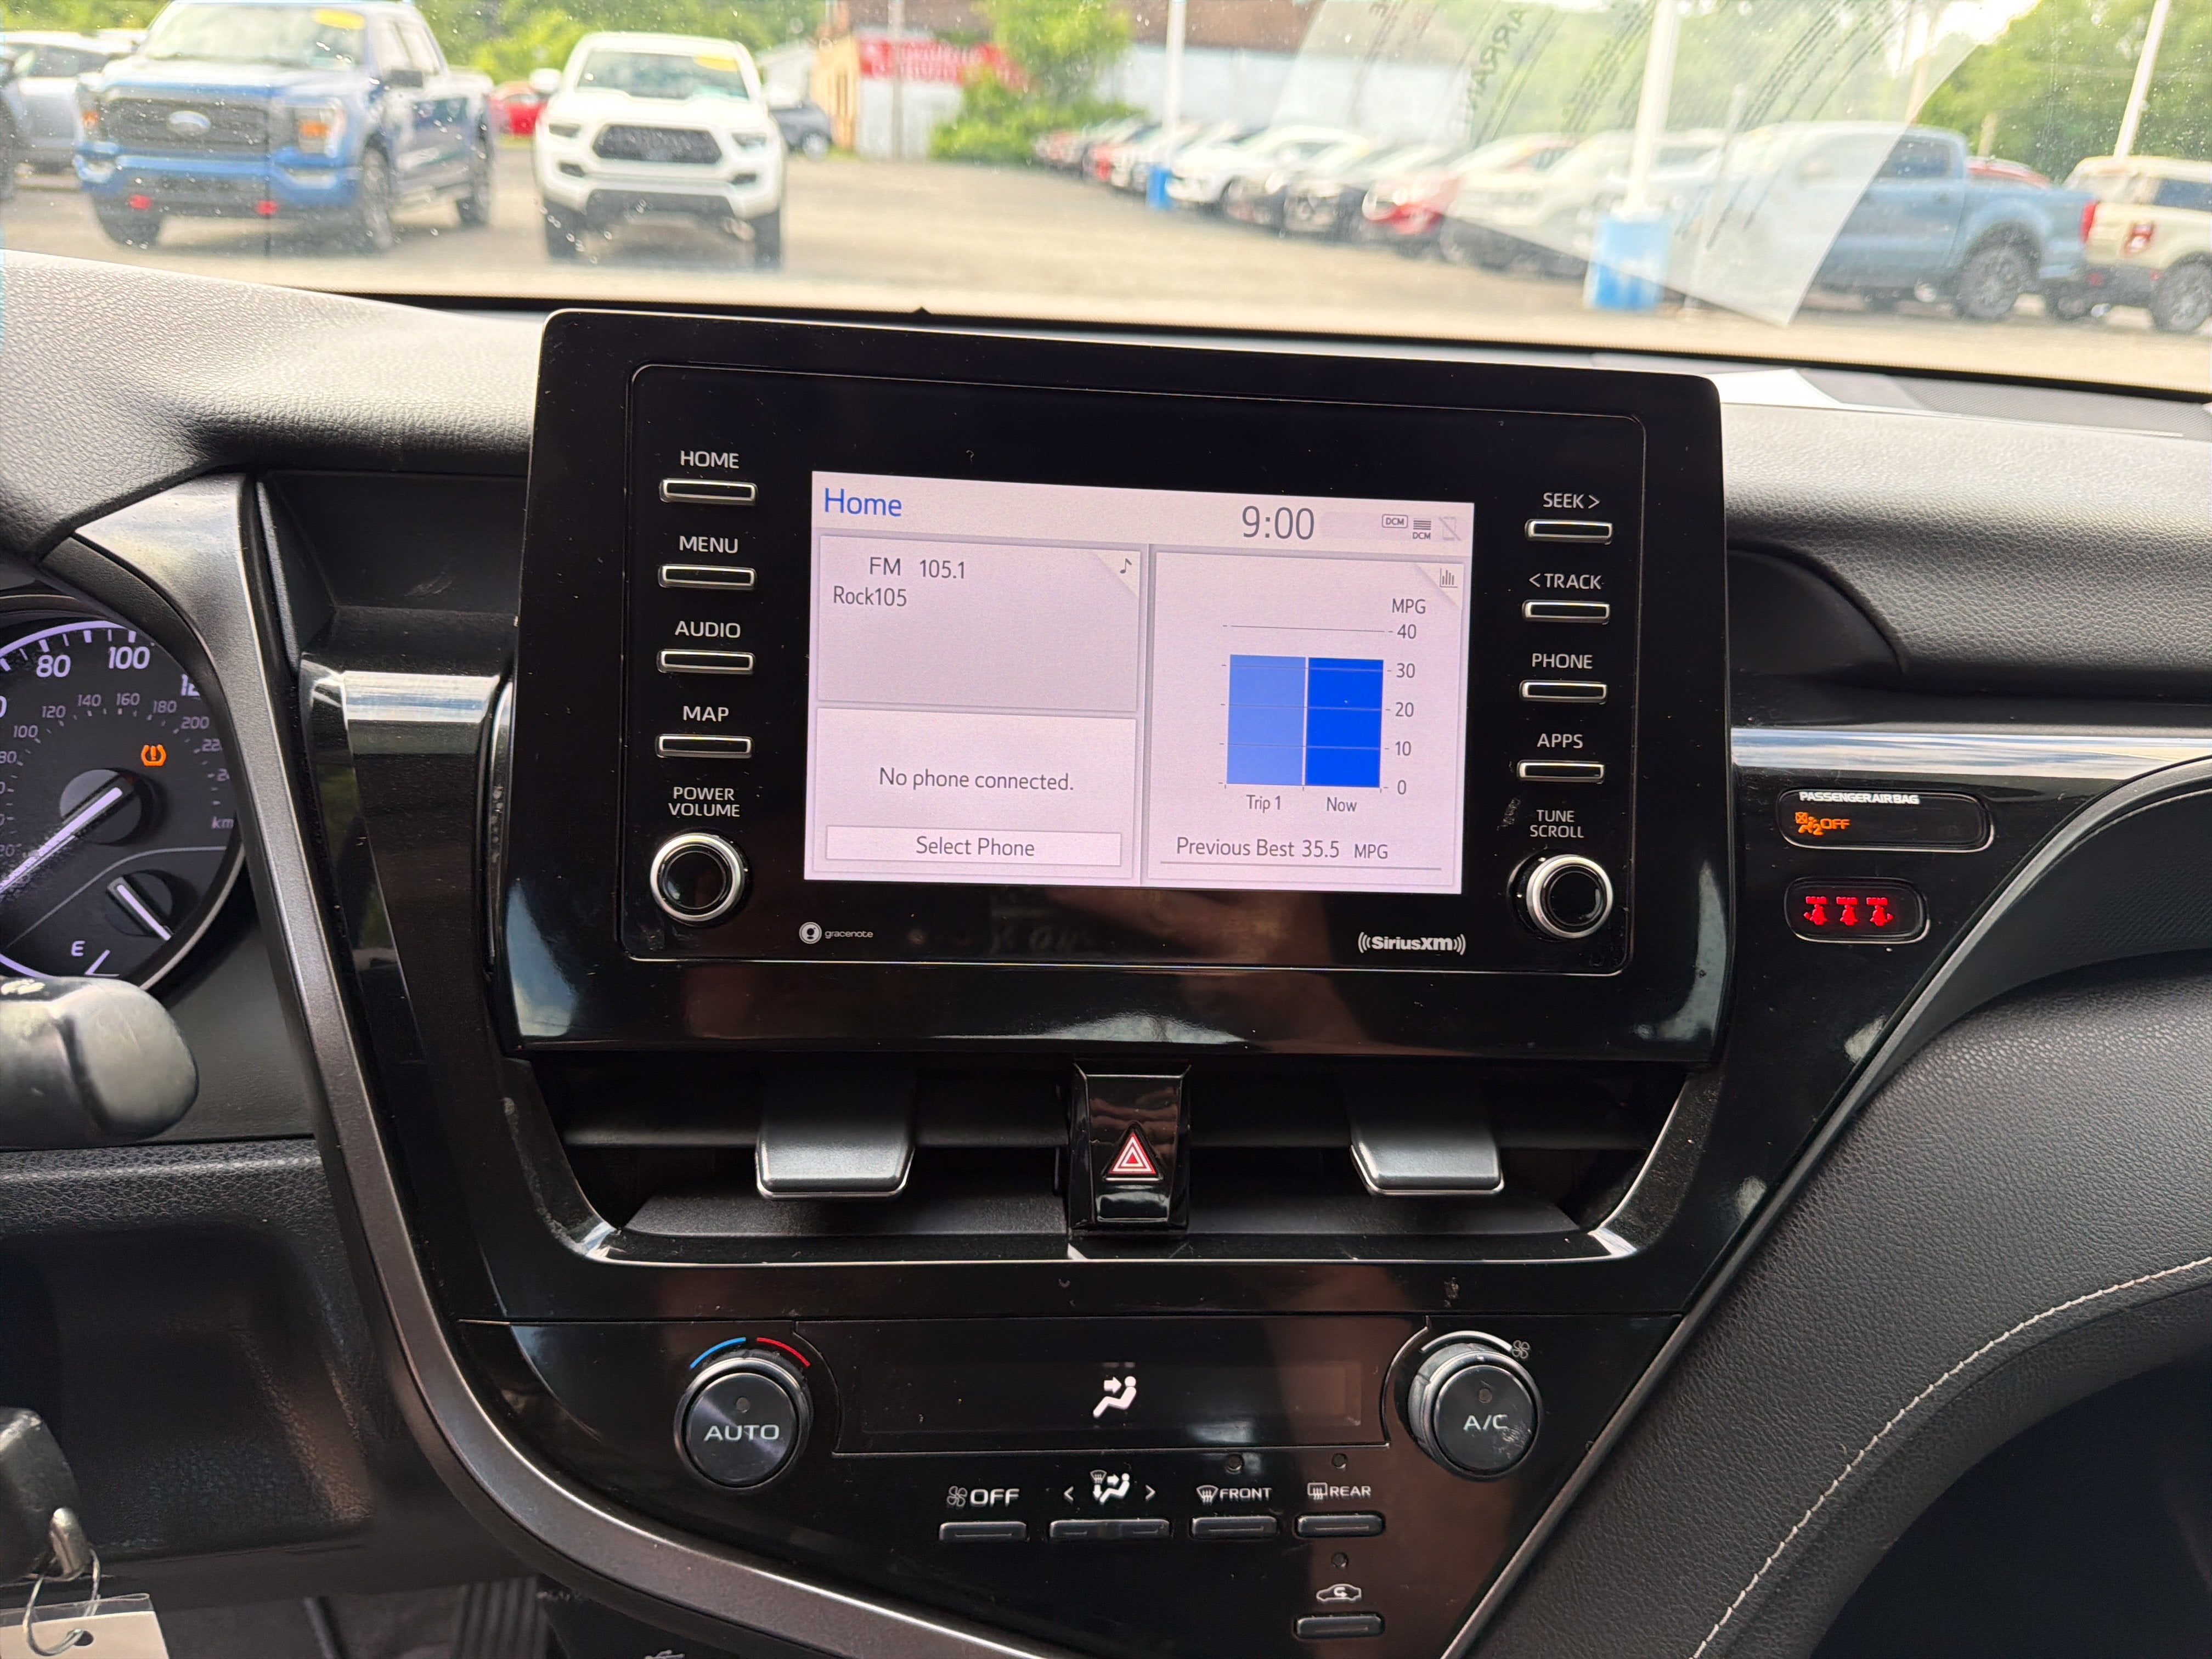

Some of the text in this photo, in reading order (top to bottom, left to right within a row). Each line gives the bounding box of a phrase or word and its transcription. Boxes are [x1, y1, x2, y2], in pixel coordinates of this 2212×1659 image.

[680, 450, 740, 469] HOME
[825, 488, 902, 517] Home
[1242, 505, 1314, 540] 9:00
[1386, 517, 1404, 526] DCM
[1412, 532, 1431, 540] DCM
[679, 535, 738, 554] MENU
[870, 556, 964, 579] FM 105.1
[833, 585, 907, 607] Rock105
[1392, 598, 1426, 614] MPG
[674, 620, 741, 638] AUDIO
[1397, 624, 1417, 639] 40
[109, 646, 150, 669] 100
[1532, 653, 1593, 669] PHONE
[36, 654, 71, 678] 80
[1396, 662, 1415, 679] 30
[78, 694, 101, 707] 140
[116, 692, 140, 706] 160
[153, 700, 177, 713] 180
[42, 705, 66, 718] 120
[683, 706, 729, 722] MAP
[1395, 702, 1414, 718] 20
[181, 716, 210, 729] 200
[14, 725, 38, 738] 100
[201, 738, 222, 752] 22
[1395, 741, 1412, 756] 10
[1537, 733, 1583, 749] APPS
[879, 767, 1074, 791] No phone connected.
[673, 787, 735, 801] POWER
[1397, 780, 1407, 795] 0
[1246, 794, 1281, 814] Trip 1
[1327, 797, 1357, 812] Now
[1799, 791, 1871, 804] PASSENGER
[668, 803, 740, 817] VOLUME
[1536, 809, 1575, 822] TUNE
[1530, 825, 1584, 838] SCROLL
[1820, 818, 1850, 830] OFF
[916, 836, 1035, 856] Select Phone
[1177, 837, 1388, 859] Previous Best 35.5 MPG
[825, 930, 874, 939] gracenote
[71, 940, 85, 957] E
[1463, 1414, 1509, 1431] A/C
[704, 1424, 780, 1441] AUTO
[970, 1488, 1019, 1505] OFF
[1219, 1487, 1272, 1500] FRONT
[1329, 1486, 1371, 1497] REAR
